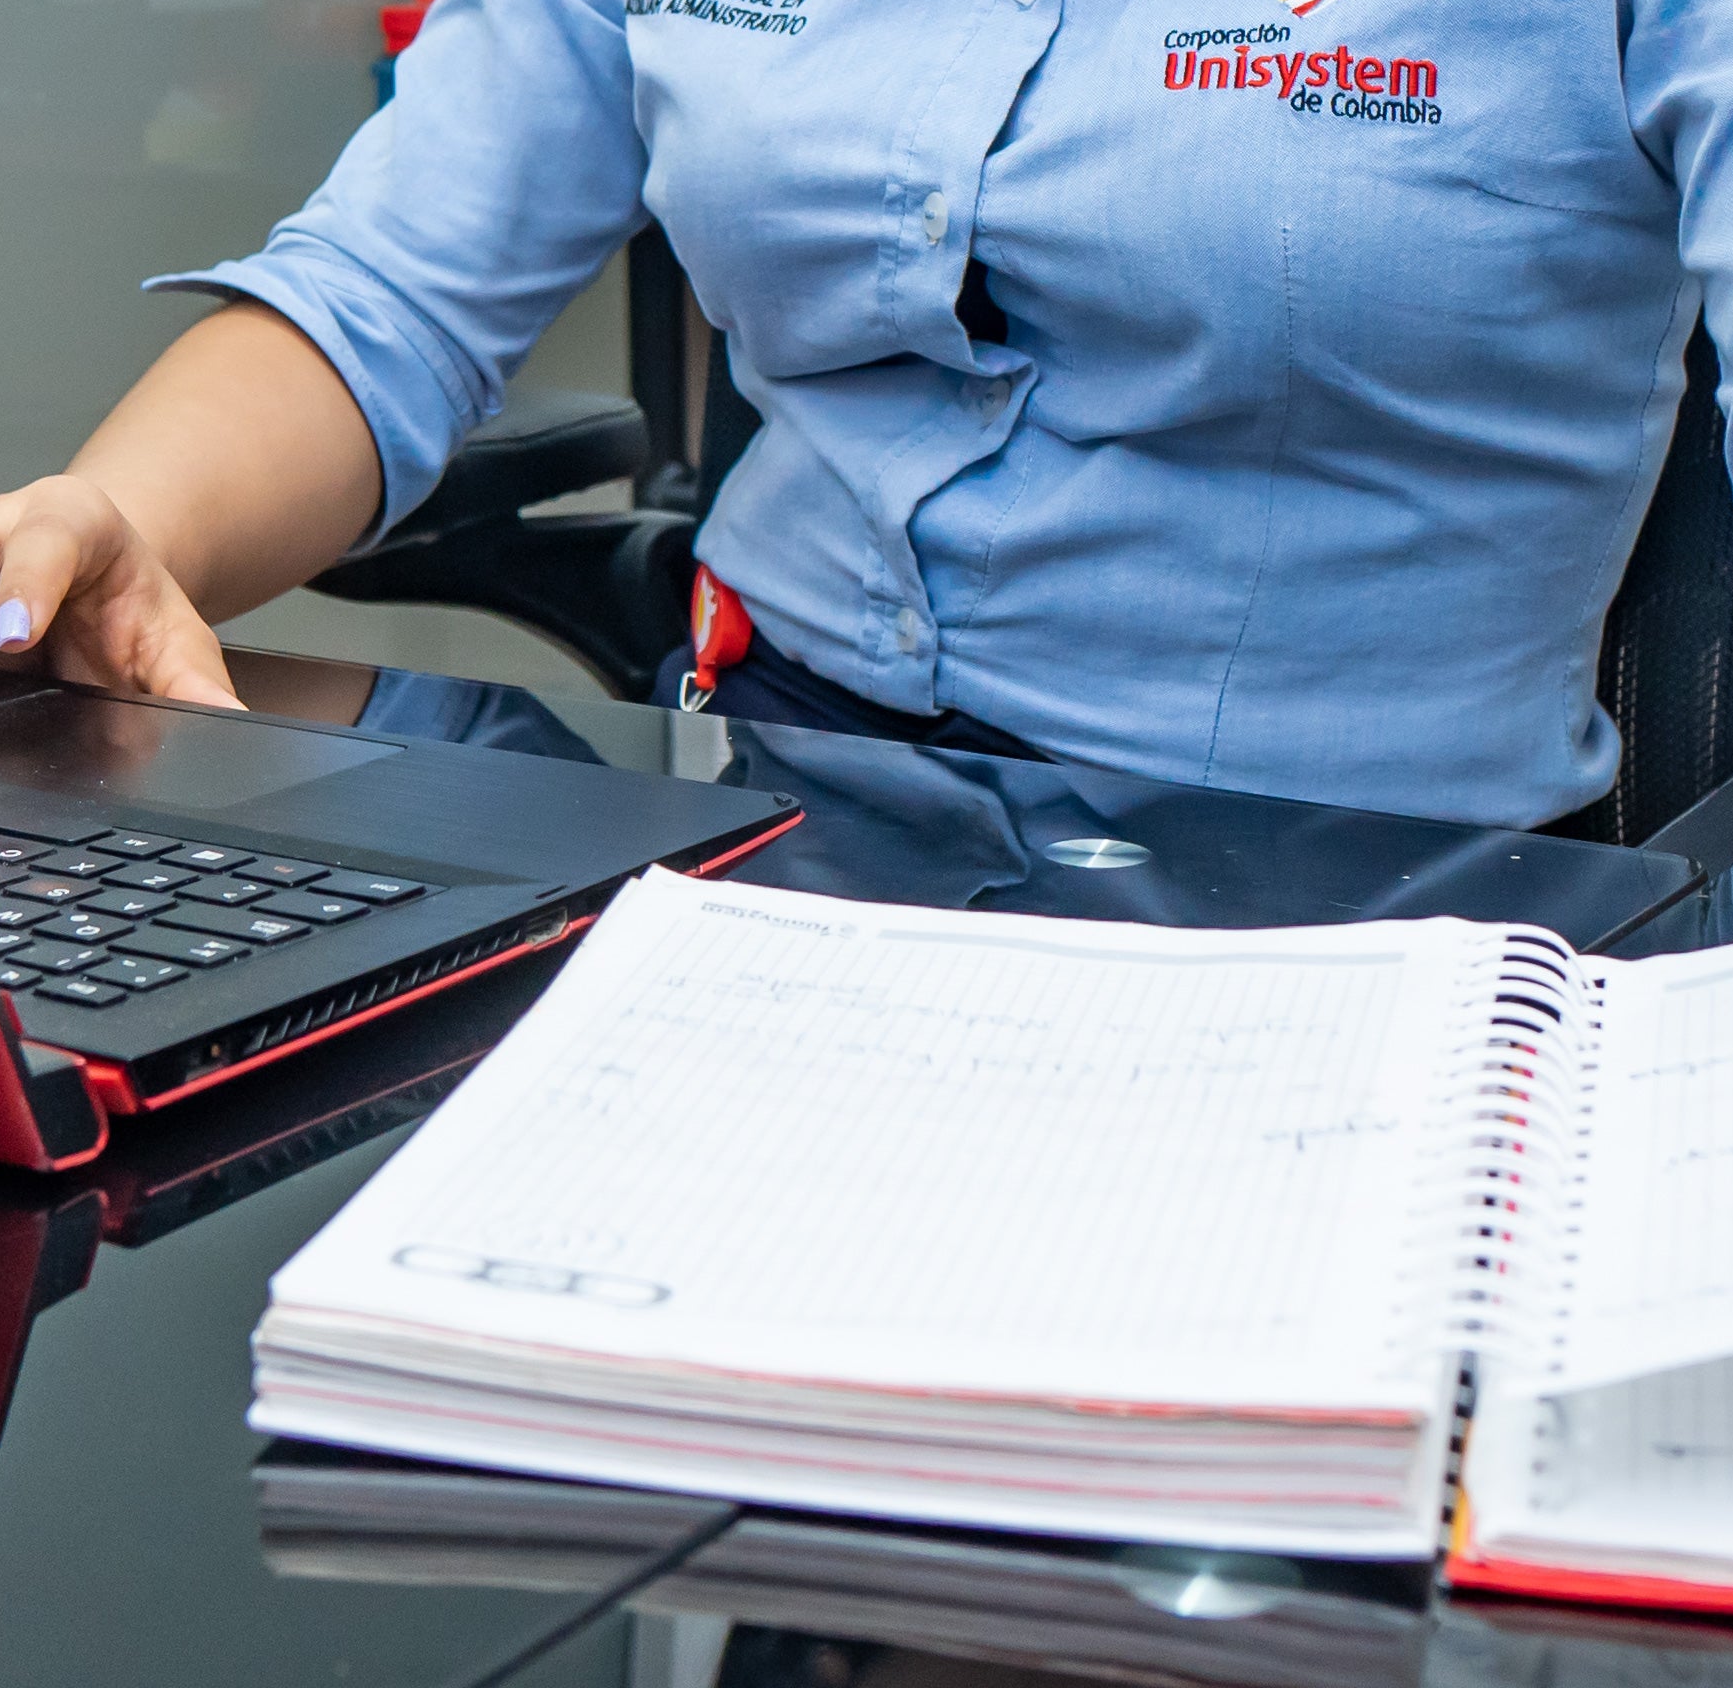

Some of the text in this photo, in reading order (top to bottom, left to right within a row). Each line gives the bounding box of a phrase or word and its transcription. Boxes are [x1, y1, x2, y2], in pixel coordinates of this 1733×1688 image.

[1163, 23, 1291, 51] Corporación
[1163, 44, 1438, 100] Unisystem
[1290, 84, 1443, 125] de Colombia
[0, 848, 23, 858] C
[68, 861, 96, 872] X
[142, 875, 170, 886] Z
[47, 887, 71, 898] S
